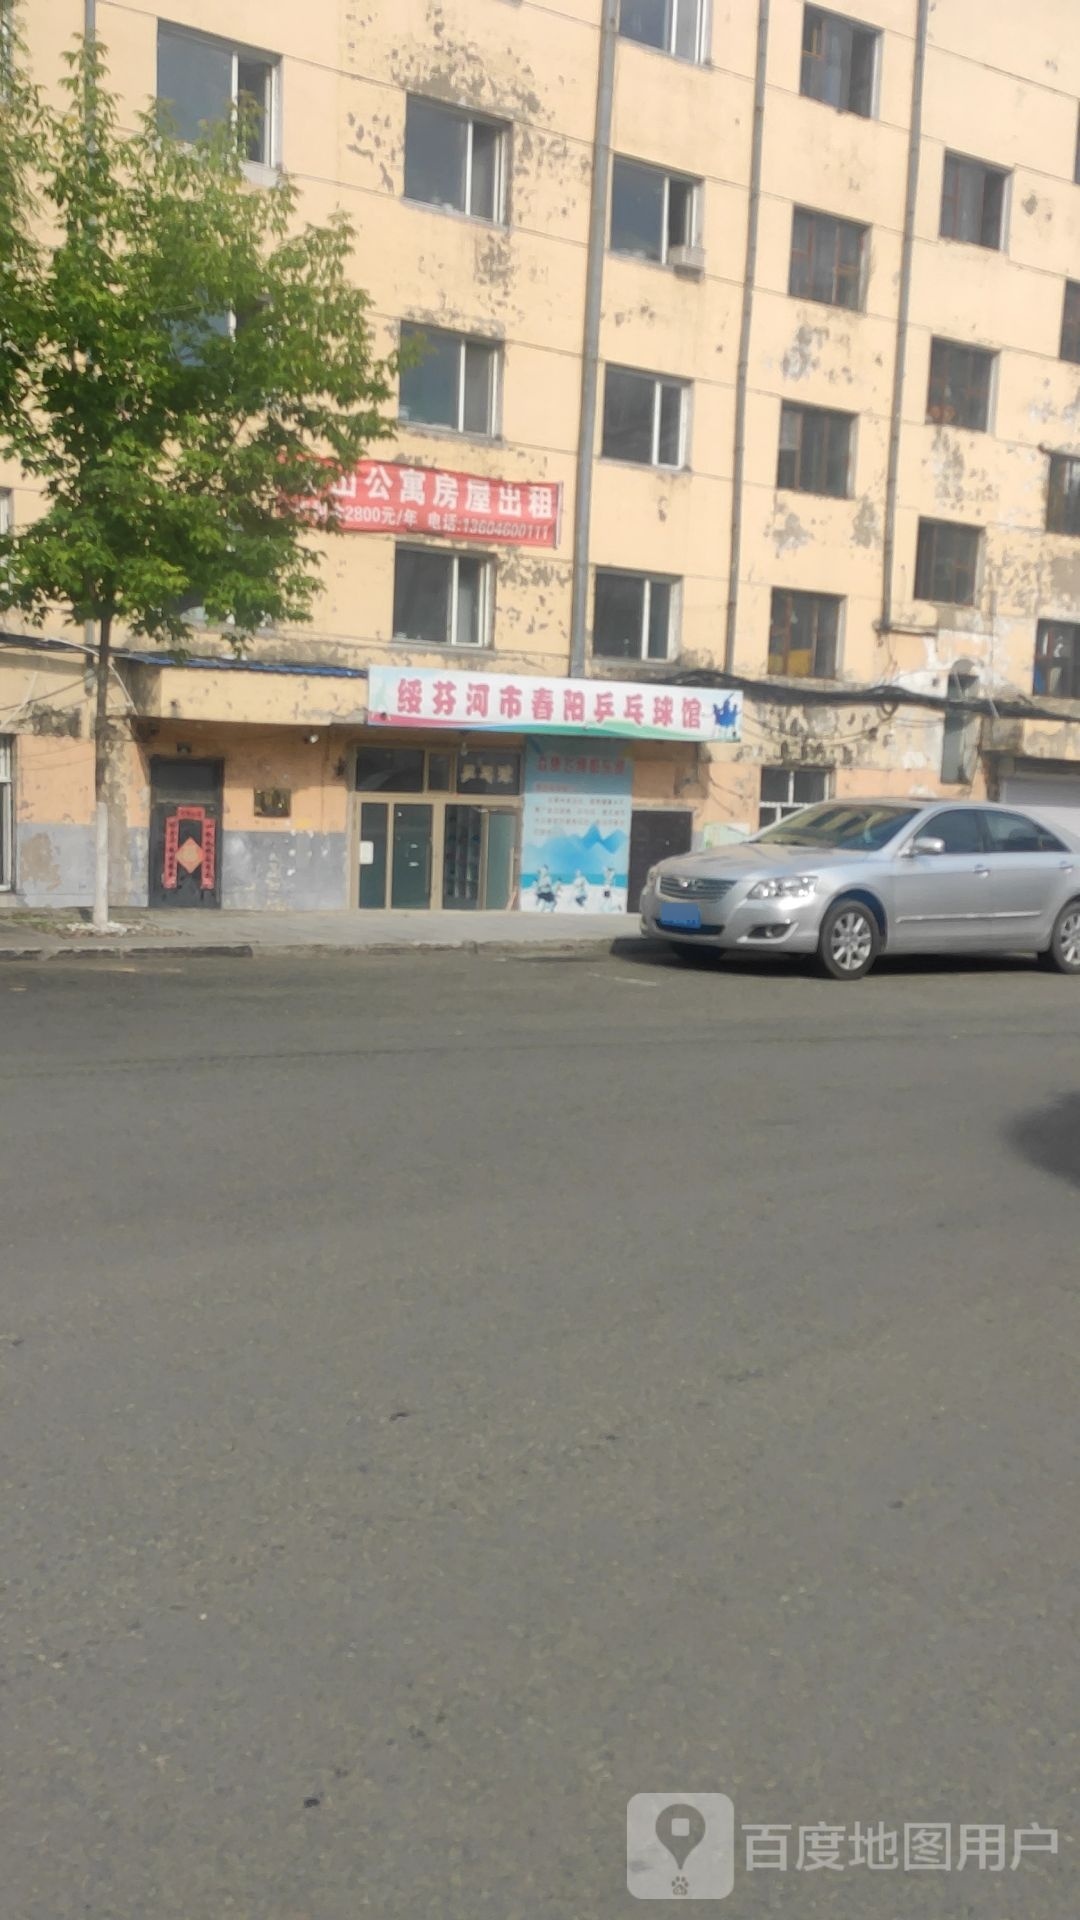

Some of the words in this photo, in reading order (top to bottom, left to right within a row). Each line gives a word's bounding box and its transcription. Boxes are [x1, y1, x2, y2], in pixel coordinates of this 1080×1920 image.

[302, 465, 552, 518] 山公寓房屋出租
[397, 678, 702, 729] 绥芬河市春阳乒乓球馆
